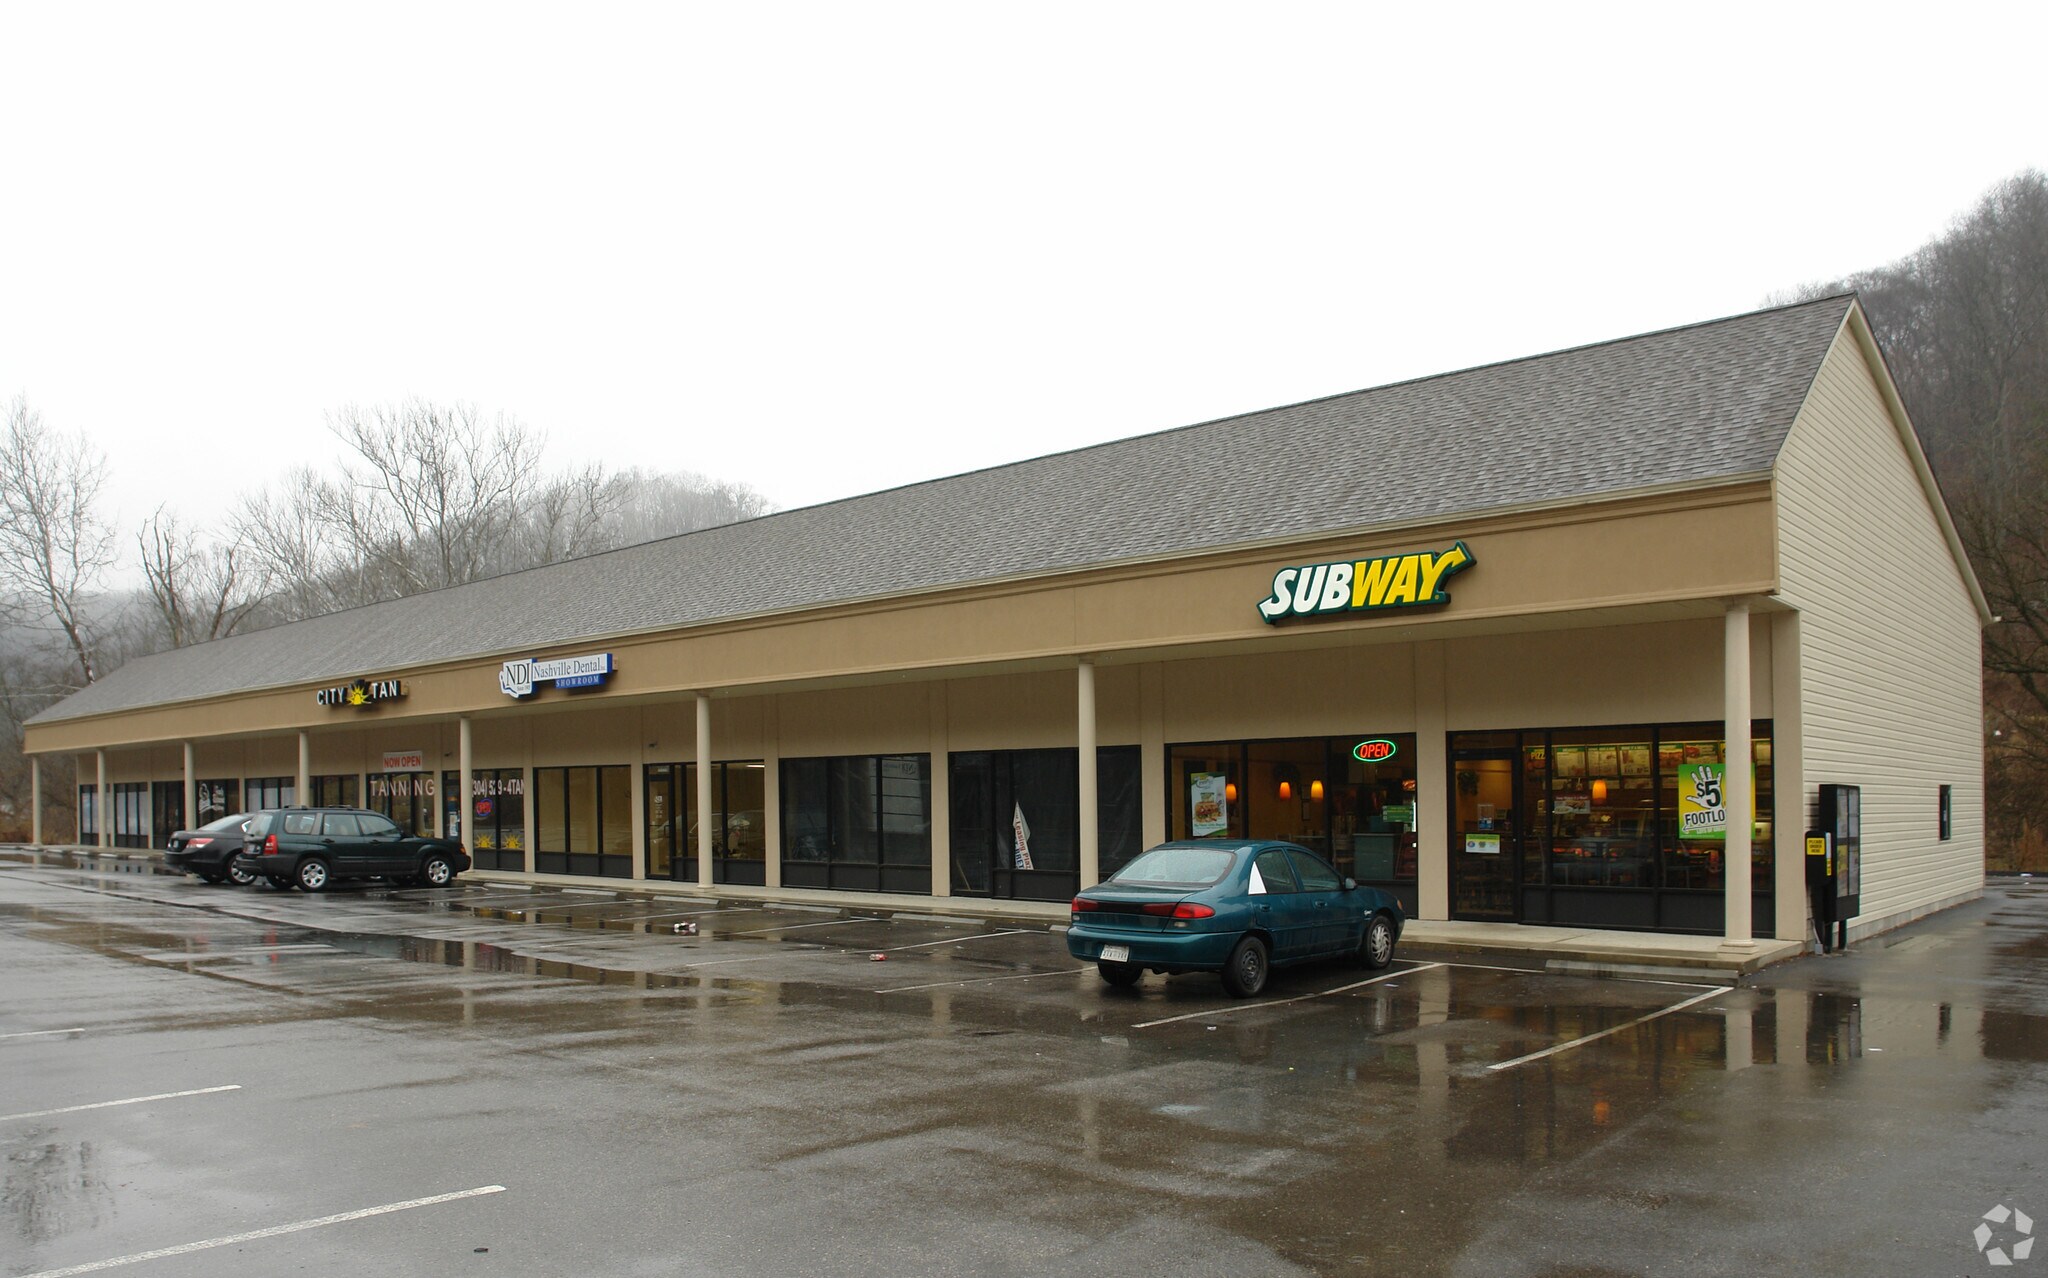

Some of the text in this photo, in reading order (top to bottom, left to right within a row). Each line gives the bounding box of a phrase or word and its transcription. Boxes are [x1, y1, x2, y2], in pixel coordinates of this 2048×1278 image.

[1259, 546, 1466, 618] SUBWAY
[505, 662, 530, 686] NDI
[534, 657, 600, 679] Nashville Dental
[316, 680, 397, 705] CITY TAN
[555, 675, 600, 688] SHOWROOM
[384, 755, 421, 768] NOW OPEN
[1360, 743, 1389, 758] OPEN
[370, 778, 435, 797] TANNING
[1696, 779, 1721, 807] $5
[1015, 821, 1026, 852] Leasing
